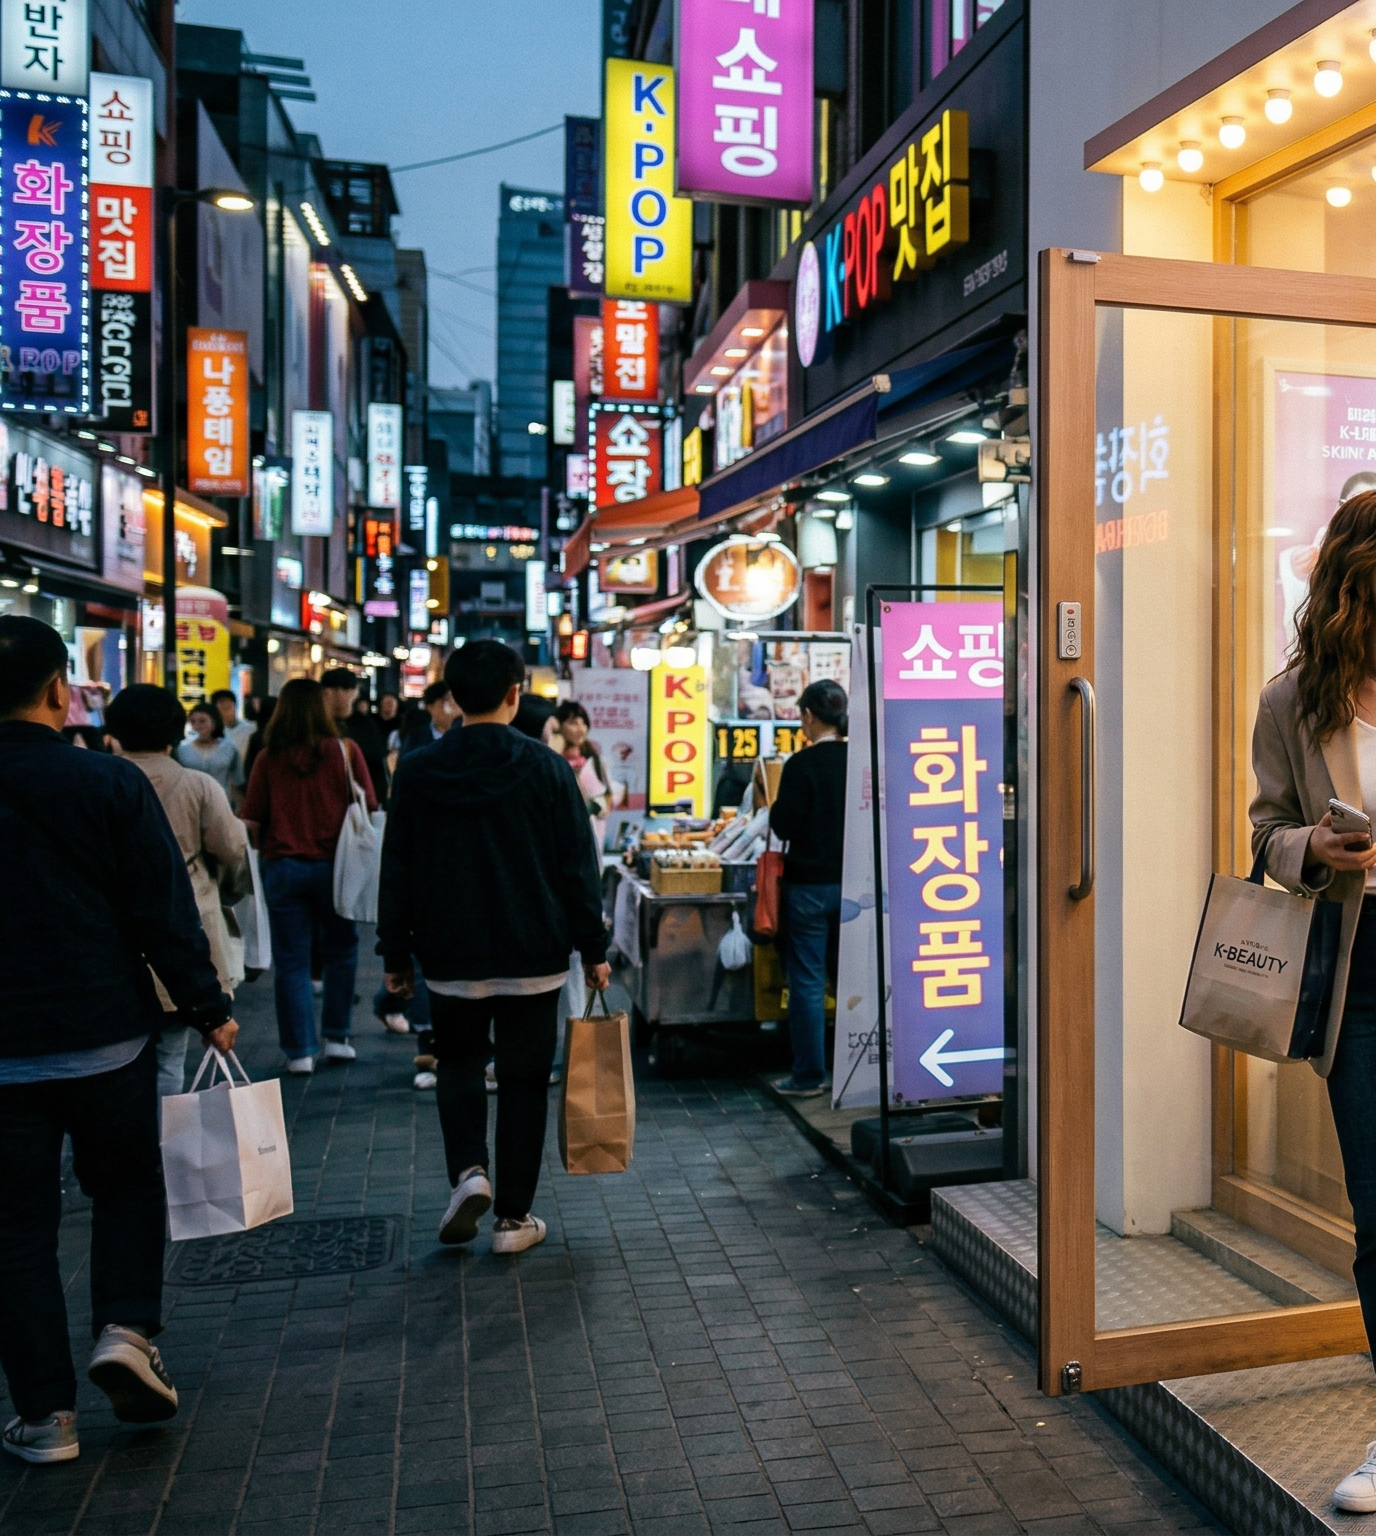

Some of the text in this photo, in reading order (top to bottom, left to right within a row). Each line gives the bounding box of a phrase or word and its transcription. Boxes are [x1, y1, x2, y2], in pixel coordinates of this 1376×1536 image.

[23, 0, 64, 81] 반자
[97, 91, 134, 165] 쇼핑
[13, 159, 74, 334] 화장품
[96, 197, 138, 281] 맛집
[826, 109, 951, 333] K-POP 맛집
[908, 724, 991, 1009] 화장품
[1213, 942, 1289, 974] K-BEAUTY
